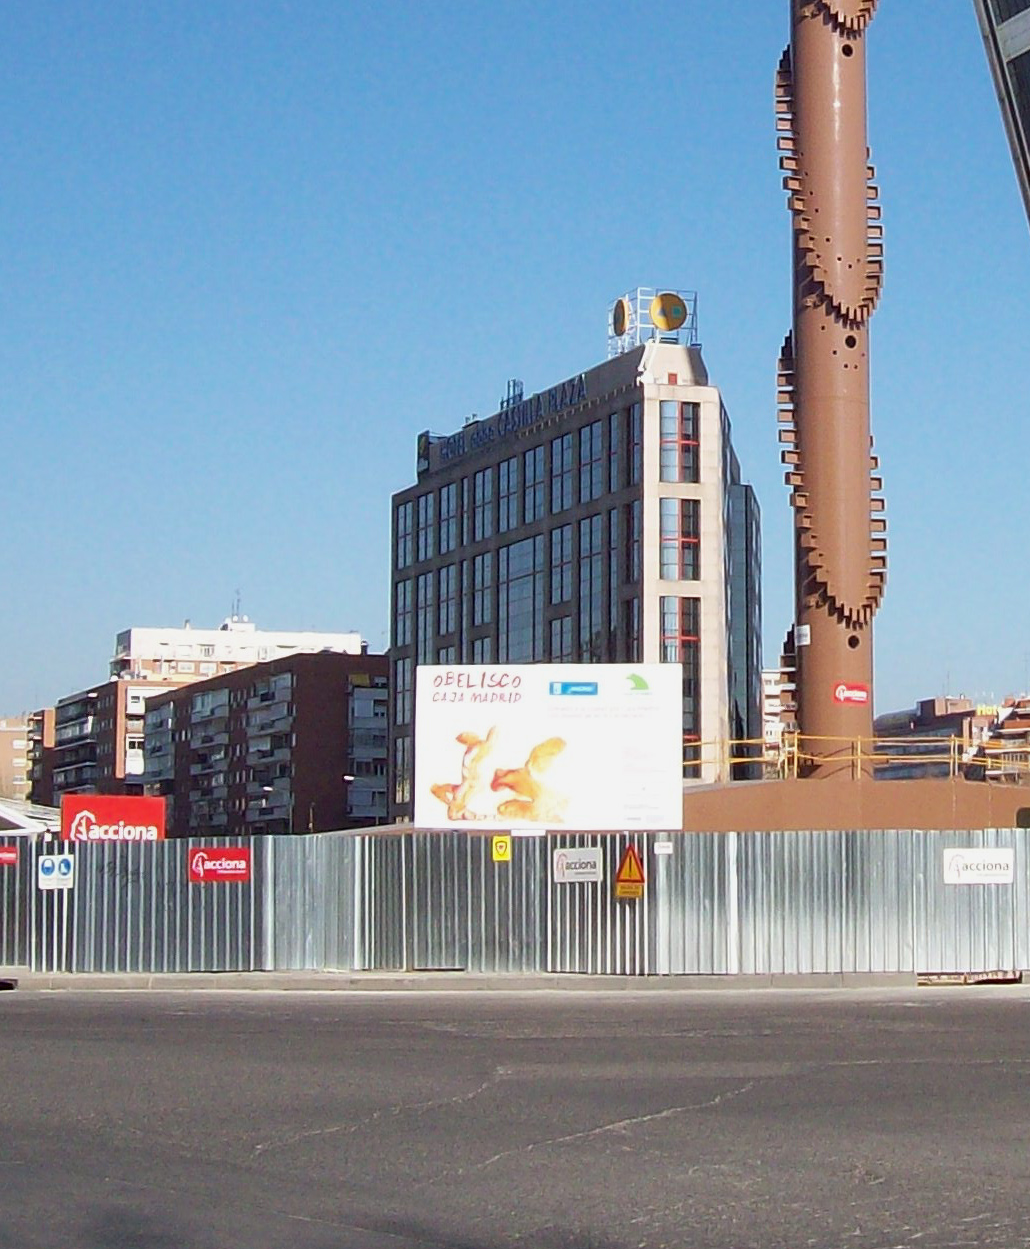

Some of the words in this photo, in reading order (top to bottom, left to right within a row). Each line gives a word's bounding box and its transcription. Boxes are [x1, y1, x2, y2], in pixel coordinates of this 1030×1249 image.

[433, 671, 522, 689] OBELISCO
[432, 691, 465, 703] CAJA
[470, 691, 522, 704] MADRID
[89, 820, 158, 841] acciona
[204, 857, 247, 870] acciona
[565, 858, 597, 870] acciona
[962, 858, 1010, 871] acciona
